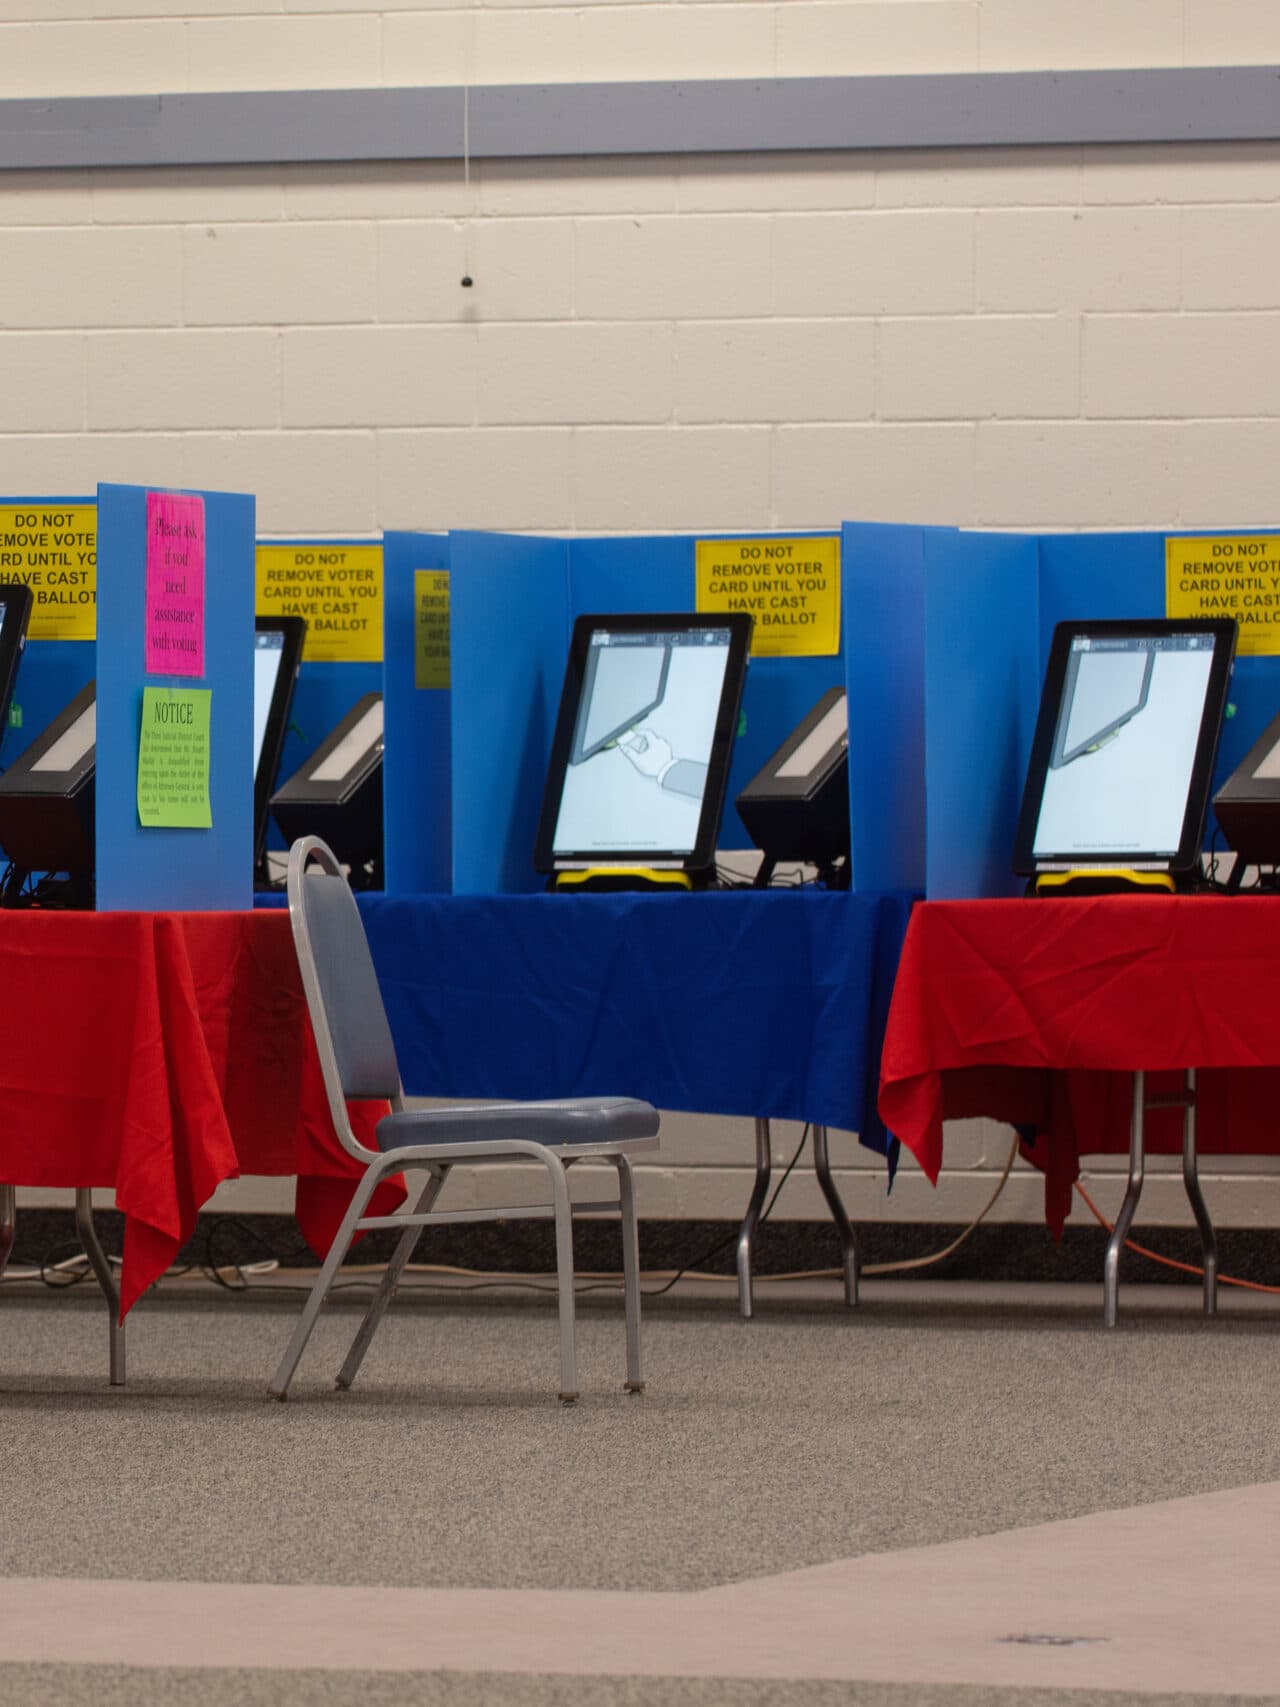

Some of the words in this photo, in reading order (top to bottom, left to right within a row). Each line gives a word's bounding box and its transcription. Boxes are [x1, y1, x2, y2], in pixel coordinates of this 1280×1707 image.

[15, 514, 37, 528] DO
[42, 514, 75, 527] NOT
[155, 517, 182, 537] Please
[183, 520, 198, 539] ask
[53, 533, 96, 547] VOTE
[740, 547, 761, 559] DO
[765, 546, 793, 558] NOT
[1212, 544, 1233, 557] DO
[1238, 543, 1268, 556] NOT
[27, 552, 72, 566] UNTIL
[77, 552, 97, 566] YO
[164, 547, 171, 566] if
[172, 552, 188, 569] you
[295, 553, 315, 565] DO
[318, 553, 346, 564] NOT
[712, 564, 770, 577] REMOVE
[775, 562, 823, 575] VOTER
[1183, 562, 1244, 575] REMOVE
[1248, 560, 1280, 573] VOT
[0, 572, 42, 585] HAVE
[47, 571, 88, 585] CAST
[267, 570, 325, 582] REMOVE
[328, 569, 374, 581] VOTER
[165, 576, 186, 595] need
[263, 587, 301, 598] CARD
[306, 586, 344, 598] UNTIL
[349, 586, 377, 598] YOU
[708, 581, 748, 594] CARD
[752, 580, 792, 593] UNTIL
[797, 579, 826, 591] YOU
[1179, 579, 1220, 592] CARD
[1225, 578, 1266, 591] UNTIL
[37, 591, 96, 605] BALLOT
[728, 597, 765, 610] HAVE
[770, 596, 807, 609] CAST
[1200, 595, 1239, 608] HAVE
[1243, 594, 1280, 607] CAST
[154, 604, 195, 624] assistance
[282, 603, 318, 615] HAVE
[322, 603, 359, 614] CAST
[314, 619, 368, 631] BALLOT
[762, 612, 817, 626] BALLOT
[1235, 611, 1280, 625] BALLO
[152, 631, 170, 651] with
[171, 633, 198, 655] voting
[154, 702, 194, 725] NOTICE
